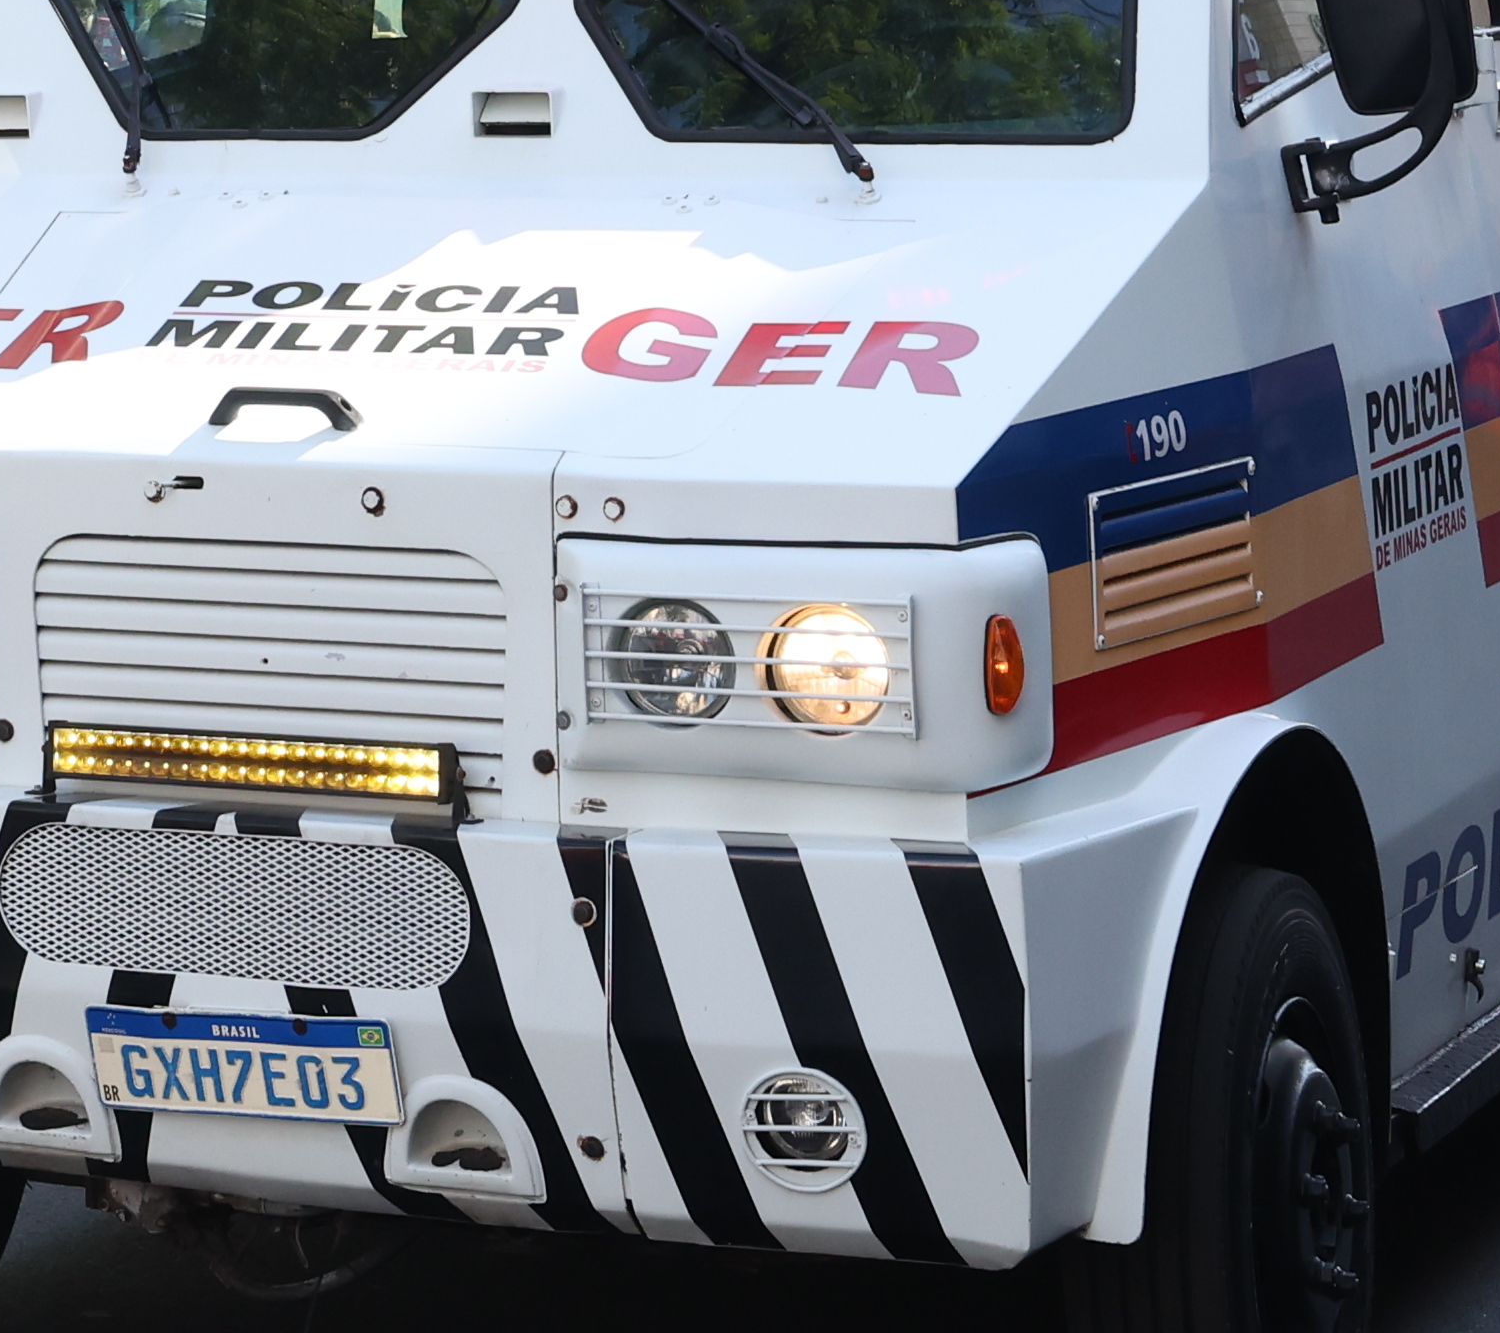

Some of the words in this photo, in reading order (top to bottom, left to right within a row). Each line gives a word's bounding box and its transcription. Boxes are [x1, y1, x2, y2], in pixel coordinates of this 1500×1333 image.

[178, 279, 580, 316] POLÍCIA
[144, 318, 566, 357] MILITAR
[369, 354, 547, 373] GERAIS
[580, 306, 980, 398] GER
[1365, 363, 1460, 455] POLÍCIA
[1135, 410, 1187, 462] 190
[1371, 443, 1465, 539] MILITAR
[1376, 543, 1392, 572] DE
[1393, 526, 1428, 564] MINAS
[1430, 505, 1467, 545] GERAIS
[211, 1024, 260, 1039] BRASIL
[103, 1084, 120, 1102] BR
[120, 1044, 366, 1111] GXH7E03
